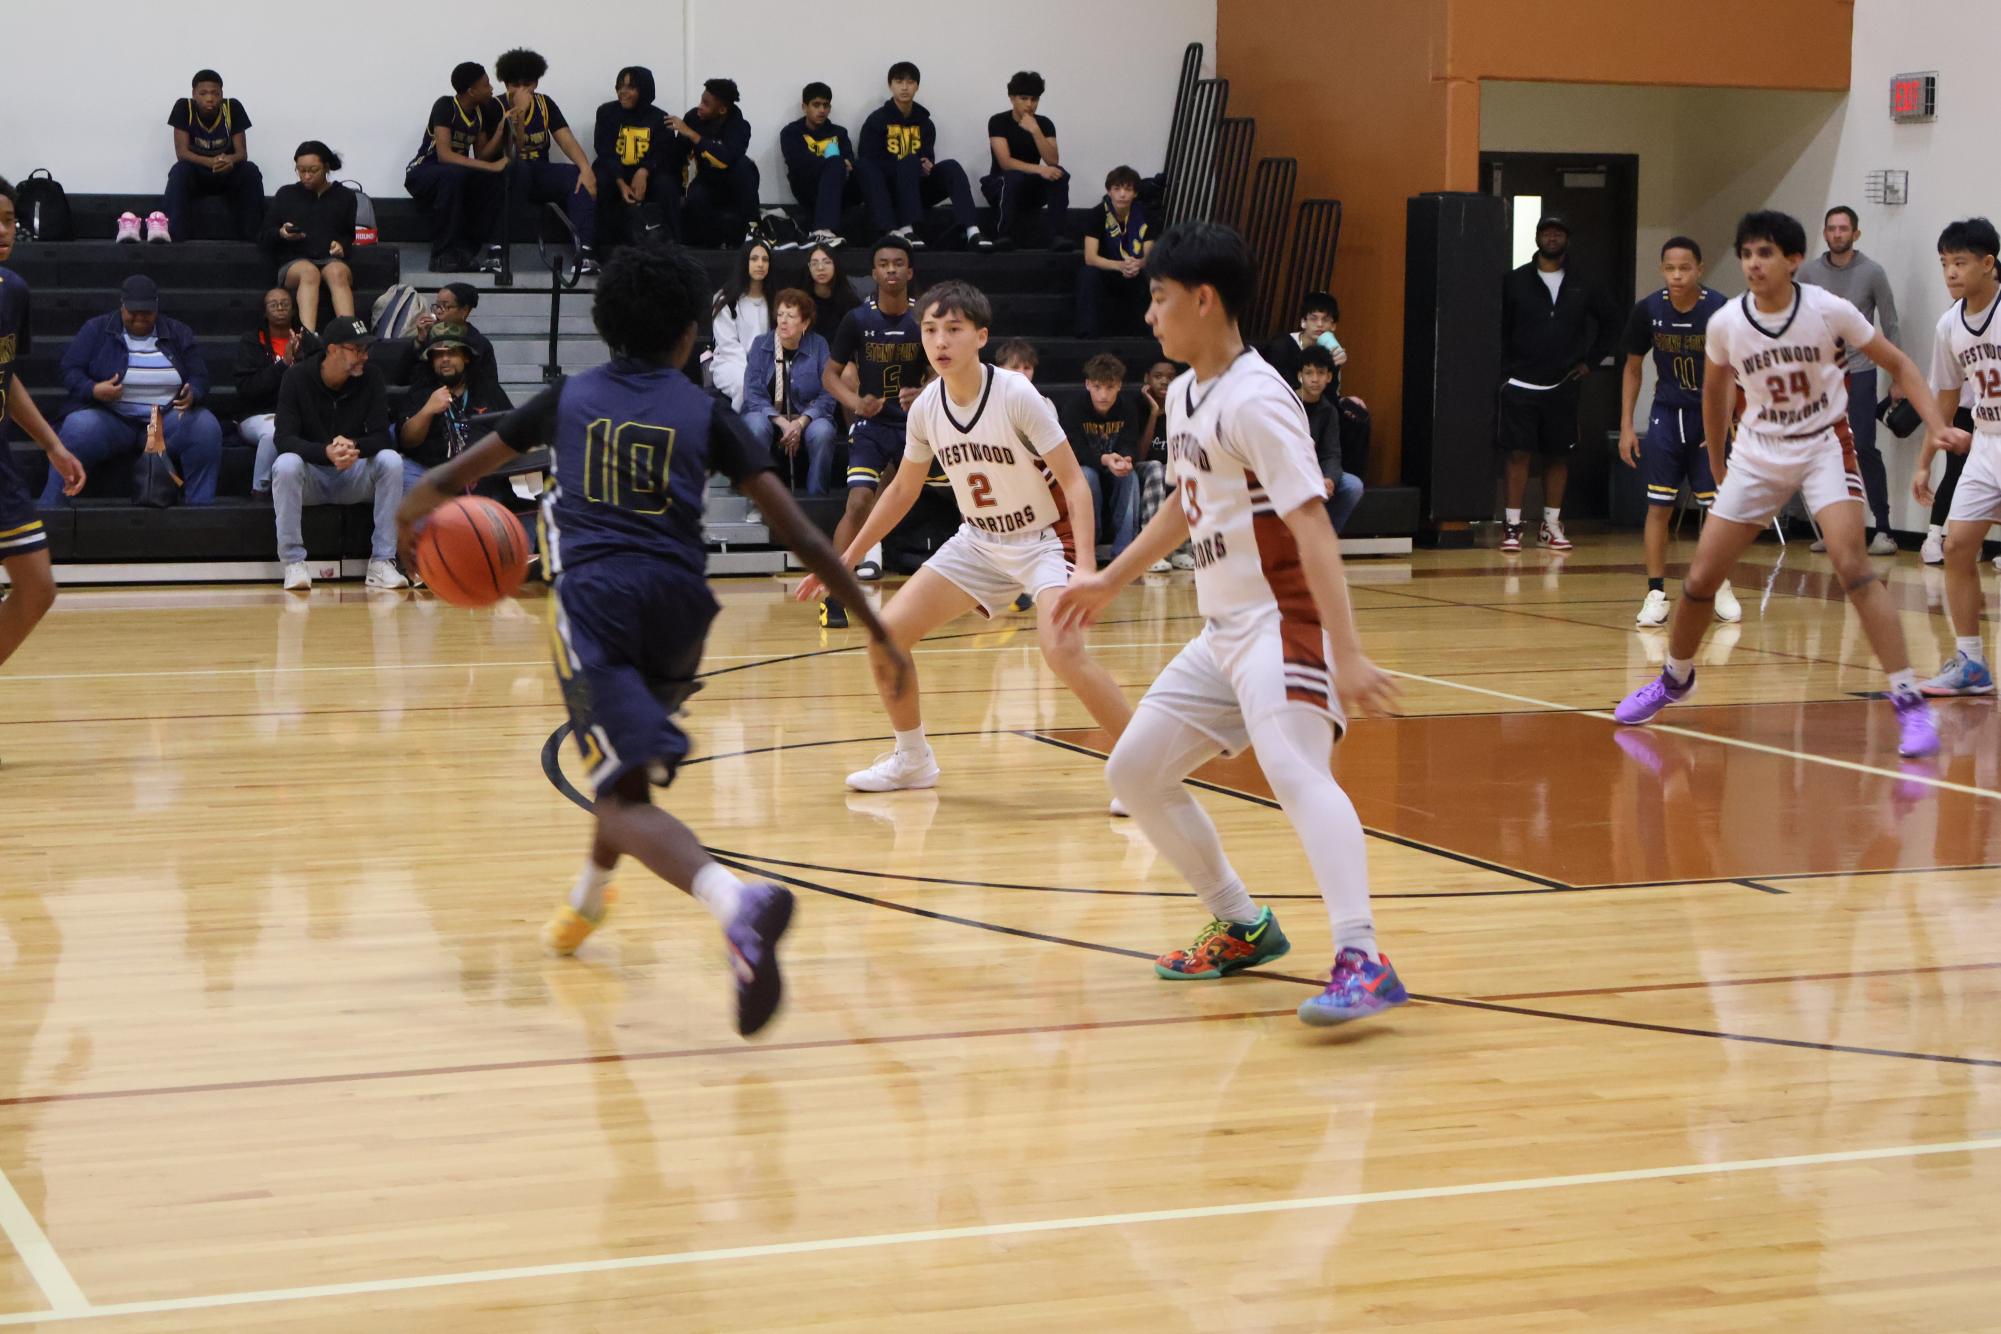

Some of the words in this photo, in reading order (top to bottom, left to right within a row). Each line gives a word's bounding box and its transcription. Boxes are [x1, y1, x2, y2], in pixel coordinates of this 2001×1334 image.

[1673, 356, 1698, 390] 11
[1766, 370, 1811, 403] 24
[1974, 368, 2001, 400] 12
[1975, 405, 2001, 421] ARRI
[583, 418, 676, 515] 10
[966, 471, 998, 508] 2
[965, 504, 1036, 533] ARRIORS
